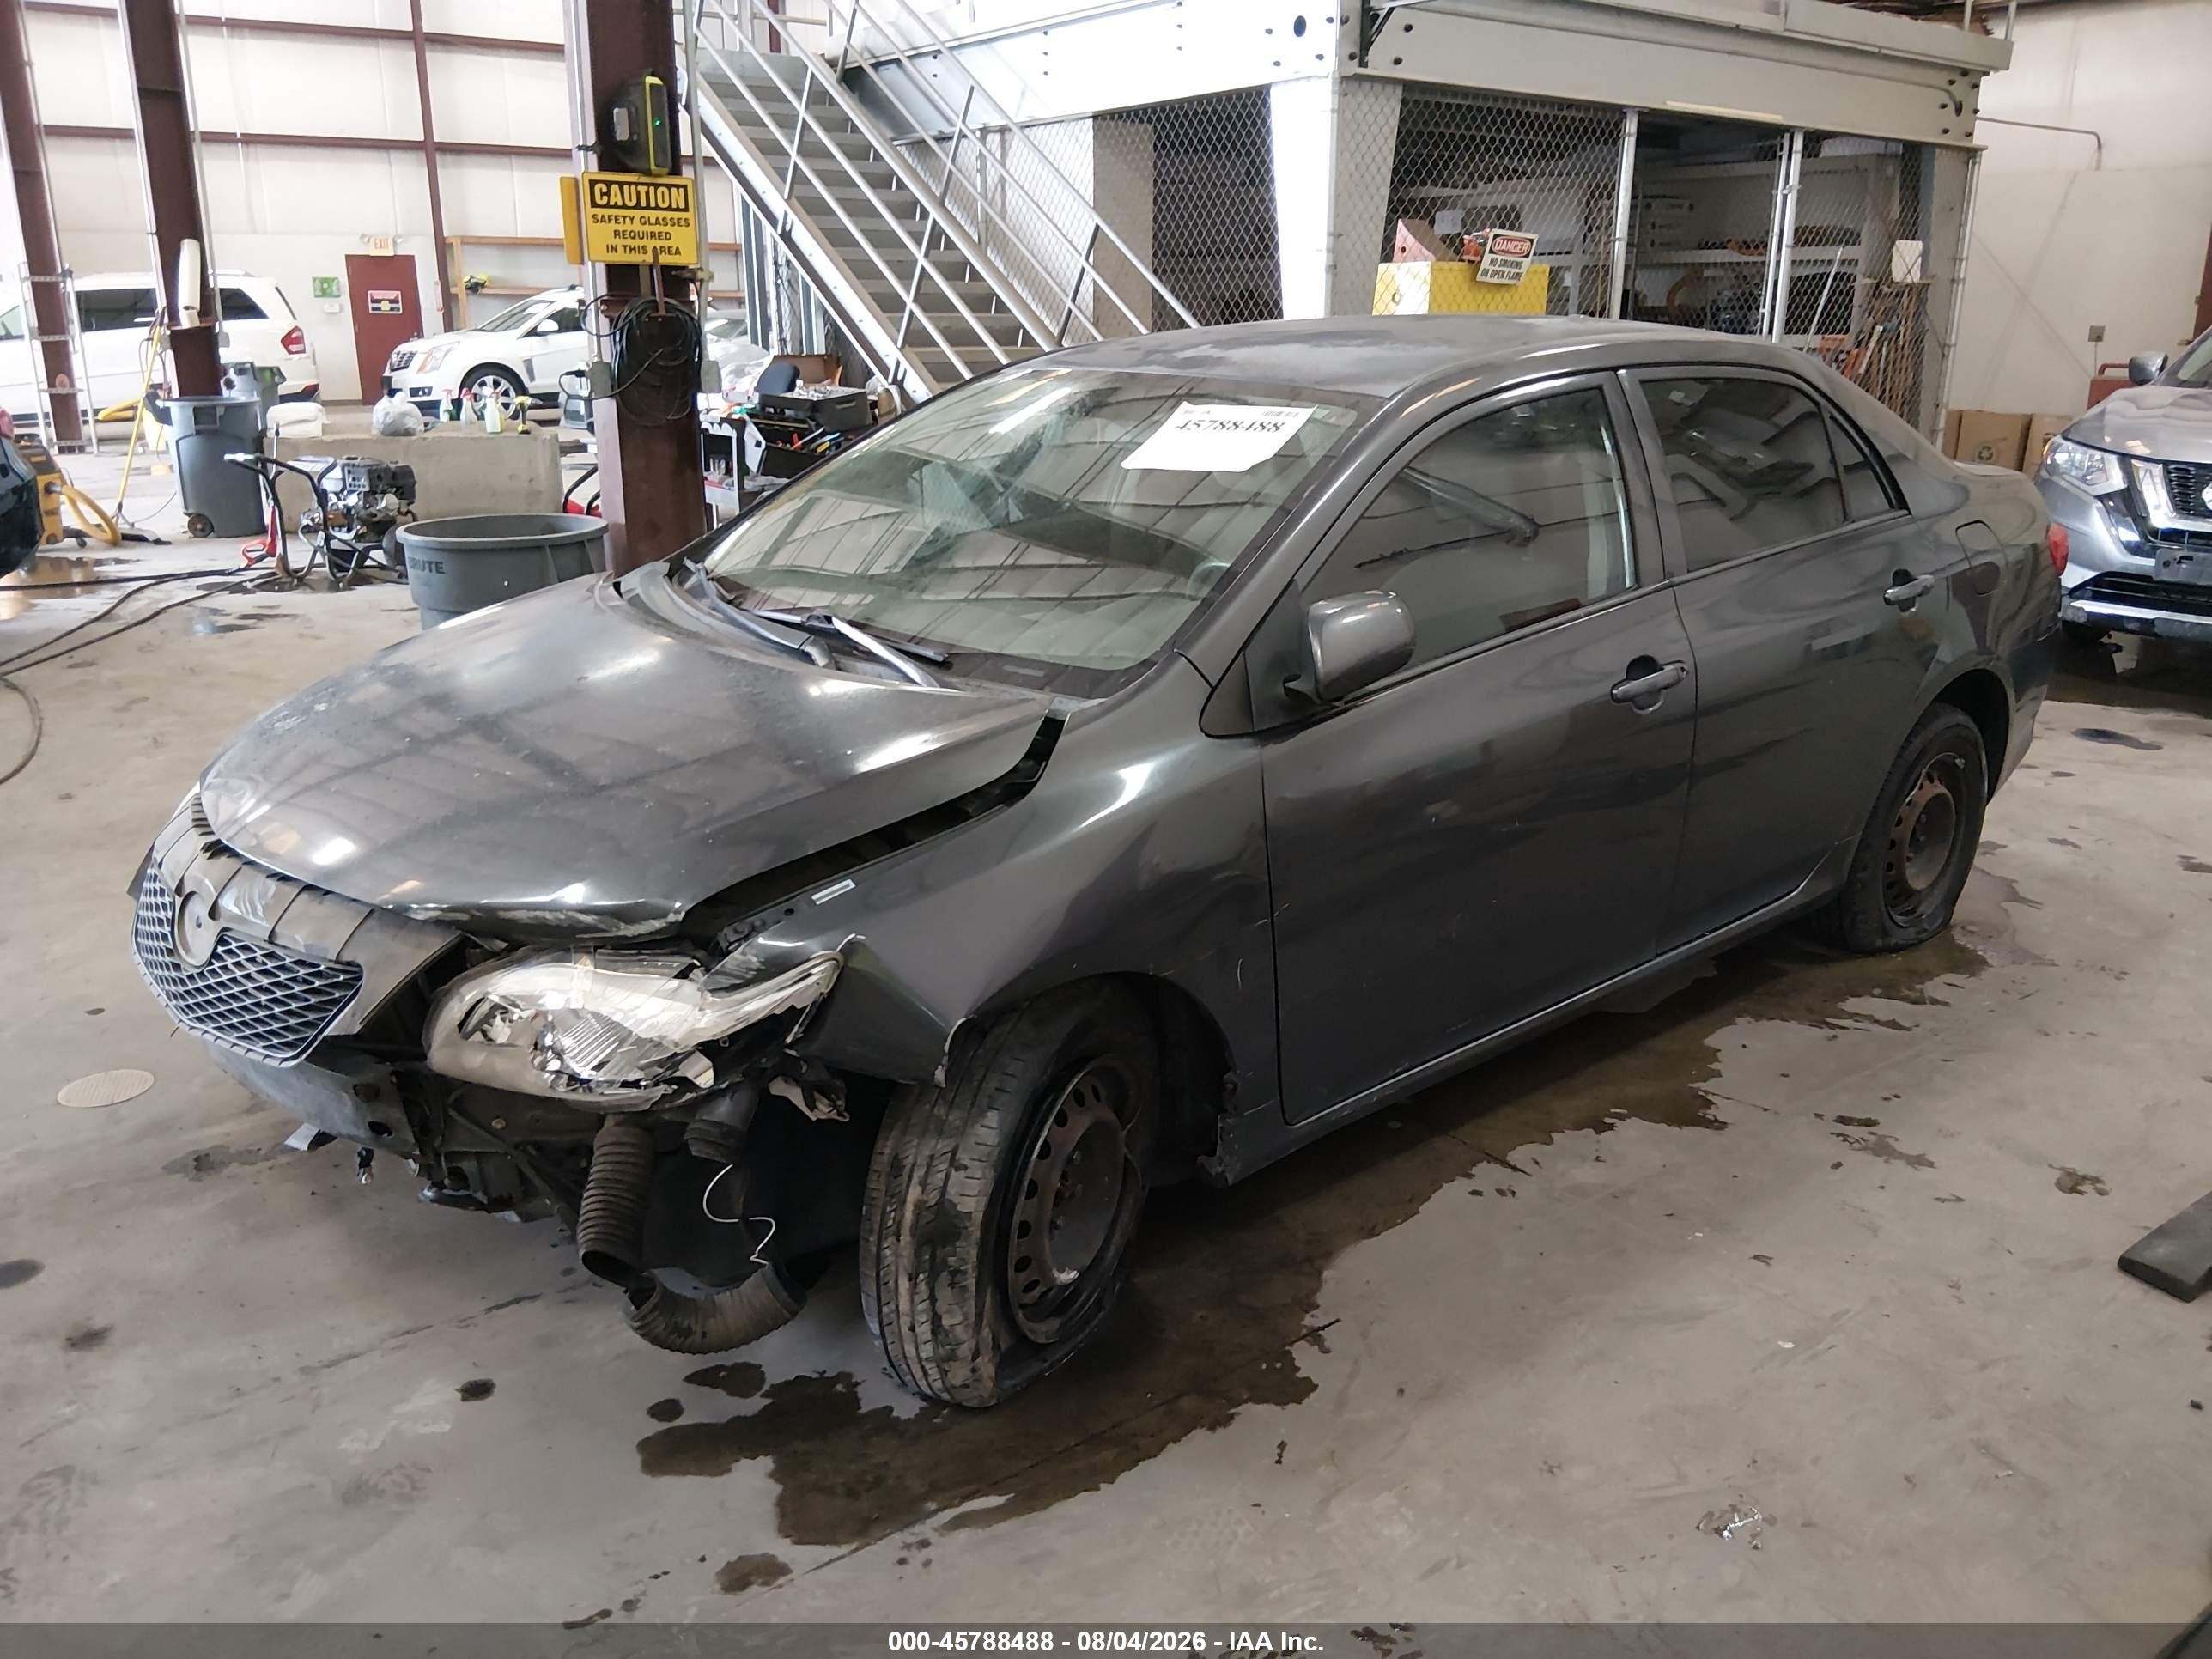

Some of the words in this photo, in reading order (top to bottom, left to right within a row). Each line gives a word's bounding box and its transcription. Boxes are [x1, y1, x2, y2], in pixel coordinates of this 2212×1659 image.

[593, 183, 686, 209] CAUTION
[592, 214, 635, 226] SAFETY
[639, 216, 690, 228] GLASSES
[613, 229, 672, 241] REQUIRED
[374, 237, 390, 250] EXIT
[605, 244, 618, 254] IN
[622, 244, 648, 255] THIS
[1494, 238, 1528, 253] DANGER
[1488, 257, 1499, 267] NO
[1498, 258, 1524, 270] SMOKING
[1480, 267, 1490, 277] OR
[1489, 268, 1506, 280] OPEN
[1175, 418, 1285, 434] 45788488
